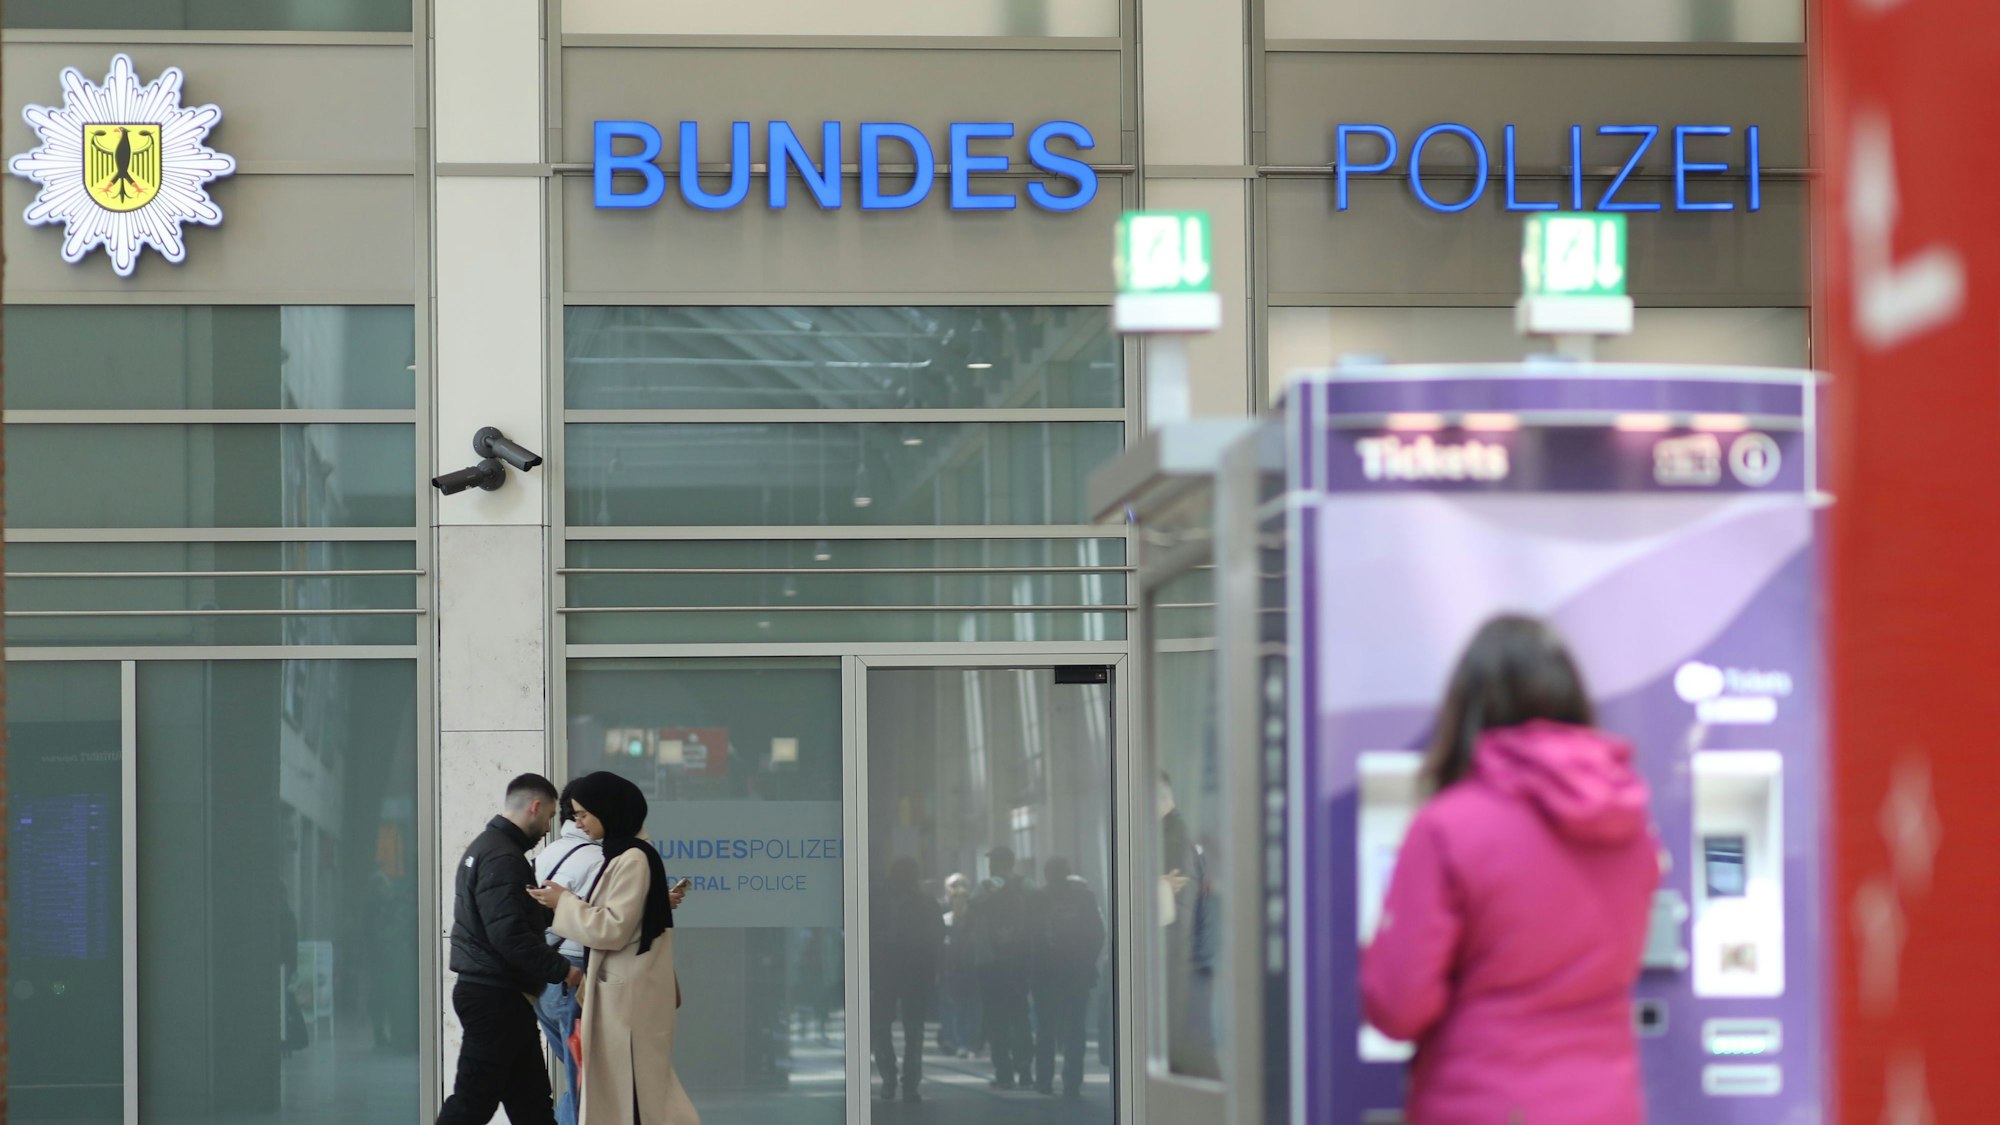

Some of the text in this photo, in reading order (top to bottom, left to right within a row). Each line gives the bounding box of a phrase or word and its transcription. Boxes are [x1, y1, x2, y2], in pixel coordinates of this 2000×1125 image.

[594, 120, 1761, 211] BUNDES POLIZEI
[653, 839, 843, 859] UNDESPOLIZEI
[737, 875, 807, 891] POLICE
